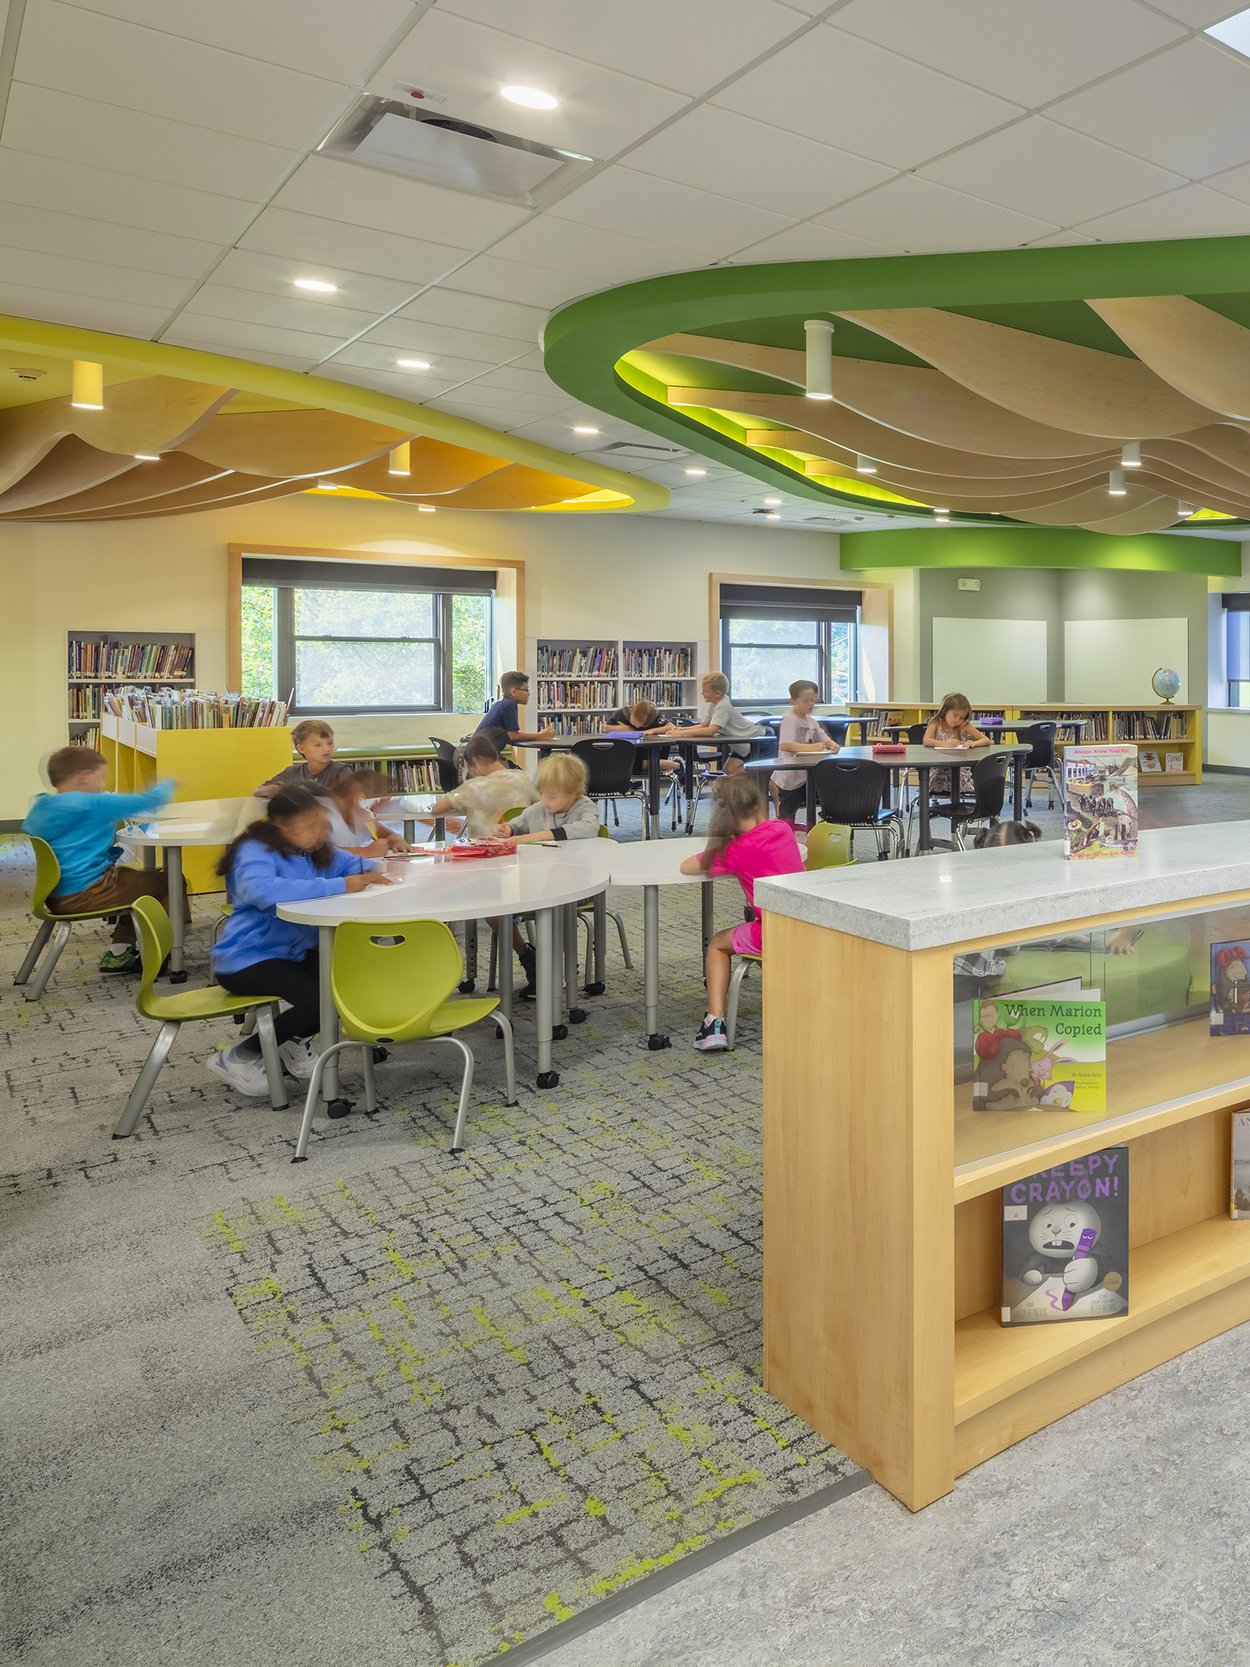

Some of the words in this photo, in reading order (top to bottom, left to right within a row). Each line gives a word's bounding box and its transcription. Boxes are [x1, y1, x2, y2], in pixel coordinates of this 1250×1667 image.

[1005, 1003, 1045, 1017] When
[1050, 1005, 1102, 1018] Marion
[1055, 1022, 1102, 1038] Copied
[1010, 1176, 1119, 1204] CRAYON!
